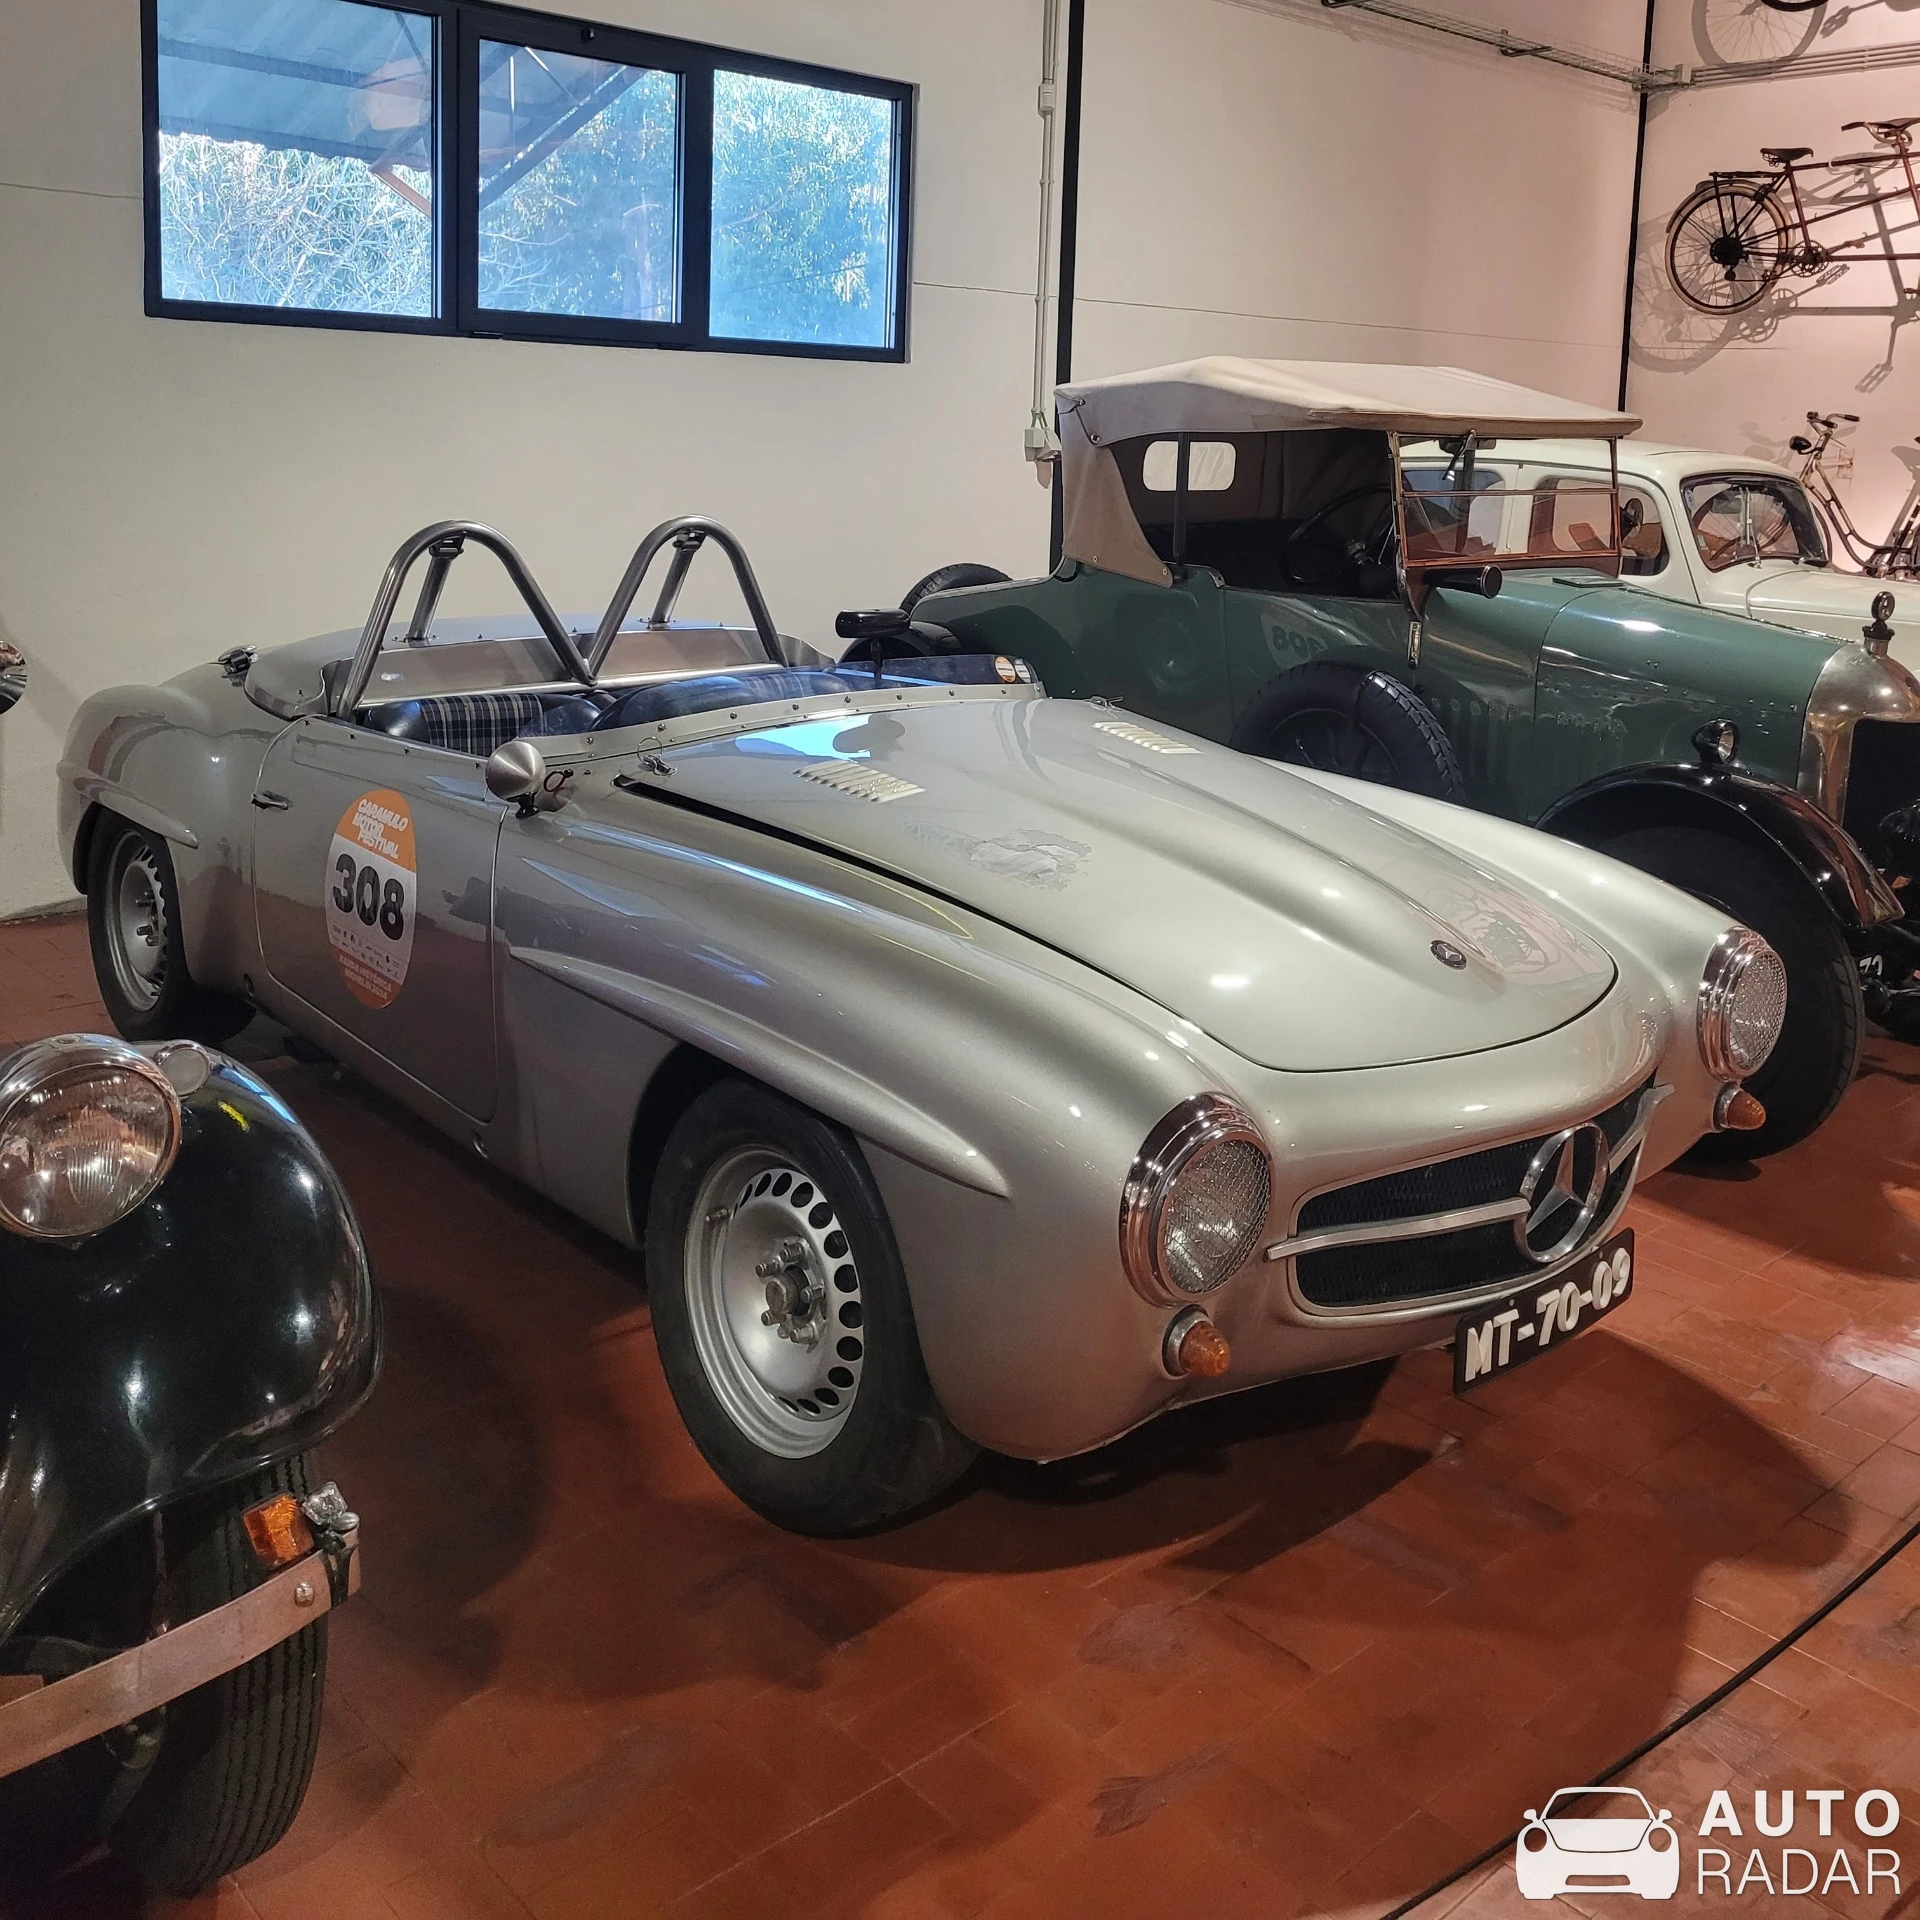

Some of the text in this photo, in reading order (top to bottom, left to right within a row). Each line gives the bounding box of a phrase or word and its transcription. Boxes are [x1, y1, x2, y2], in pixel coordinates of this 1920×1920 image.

[352, 811, 385, 838] MOTOR
[357, 798, 408, 832] CARAMULO
[357, 829, 399, 860] FESTIVAL
[333, 853, 404, 941] 308
[1465, 1247, 1631, 1382] MT-70-09
